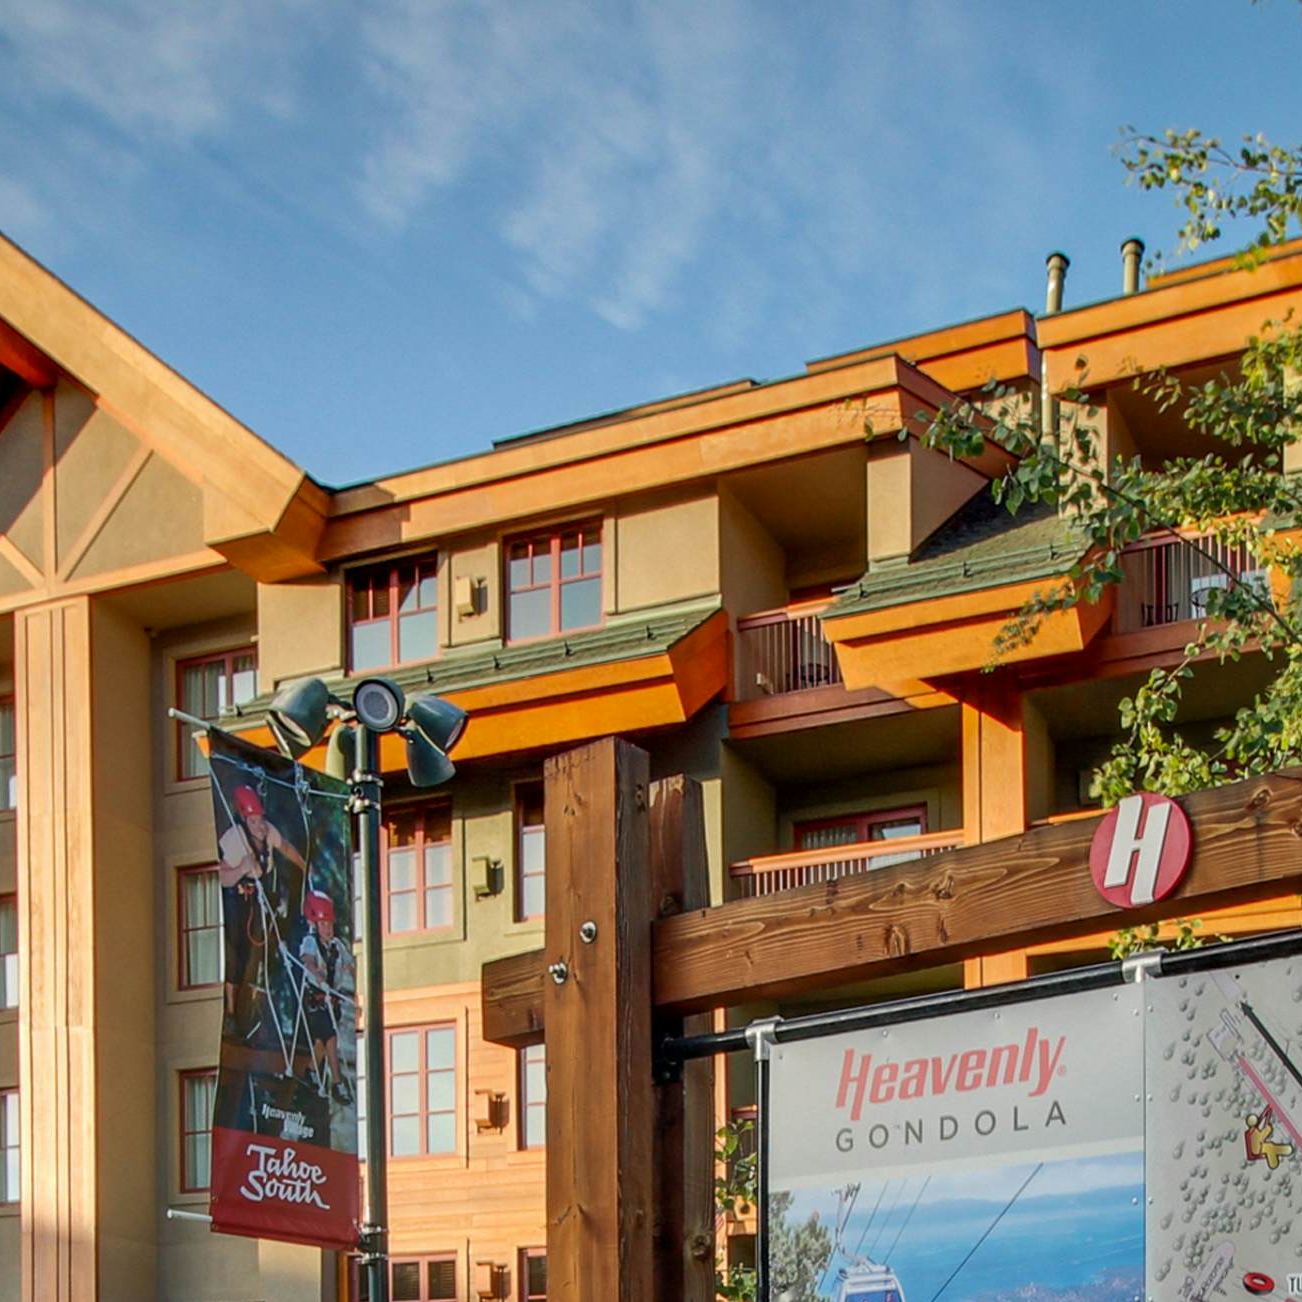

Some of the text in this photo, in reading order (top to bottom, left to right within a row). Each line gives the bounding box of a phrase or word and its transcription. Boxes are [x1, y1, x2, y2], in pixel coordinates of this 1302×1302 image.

[1103, 795, 1171, 905] H
[835, 1026, 1066, 1121] Heavenly
[835, 1100, 1067, 1152] GONDOLA
[240, 1170, 330, 1210] South
[247, 1144, 327, 1184] Tahoe
